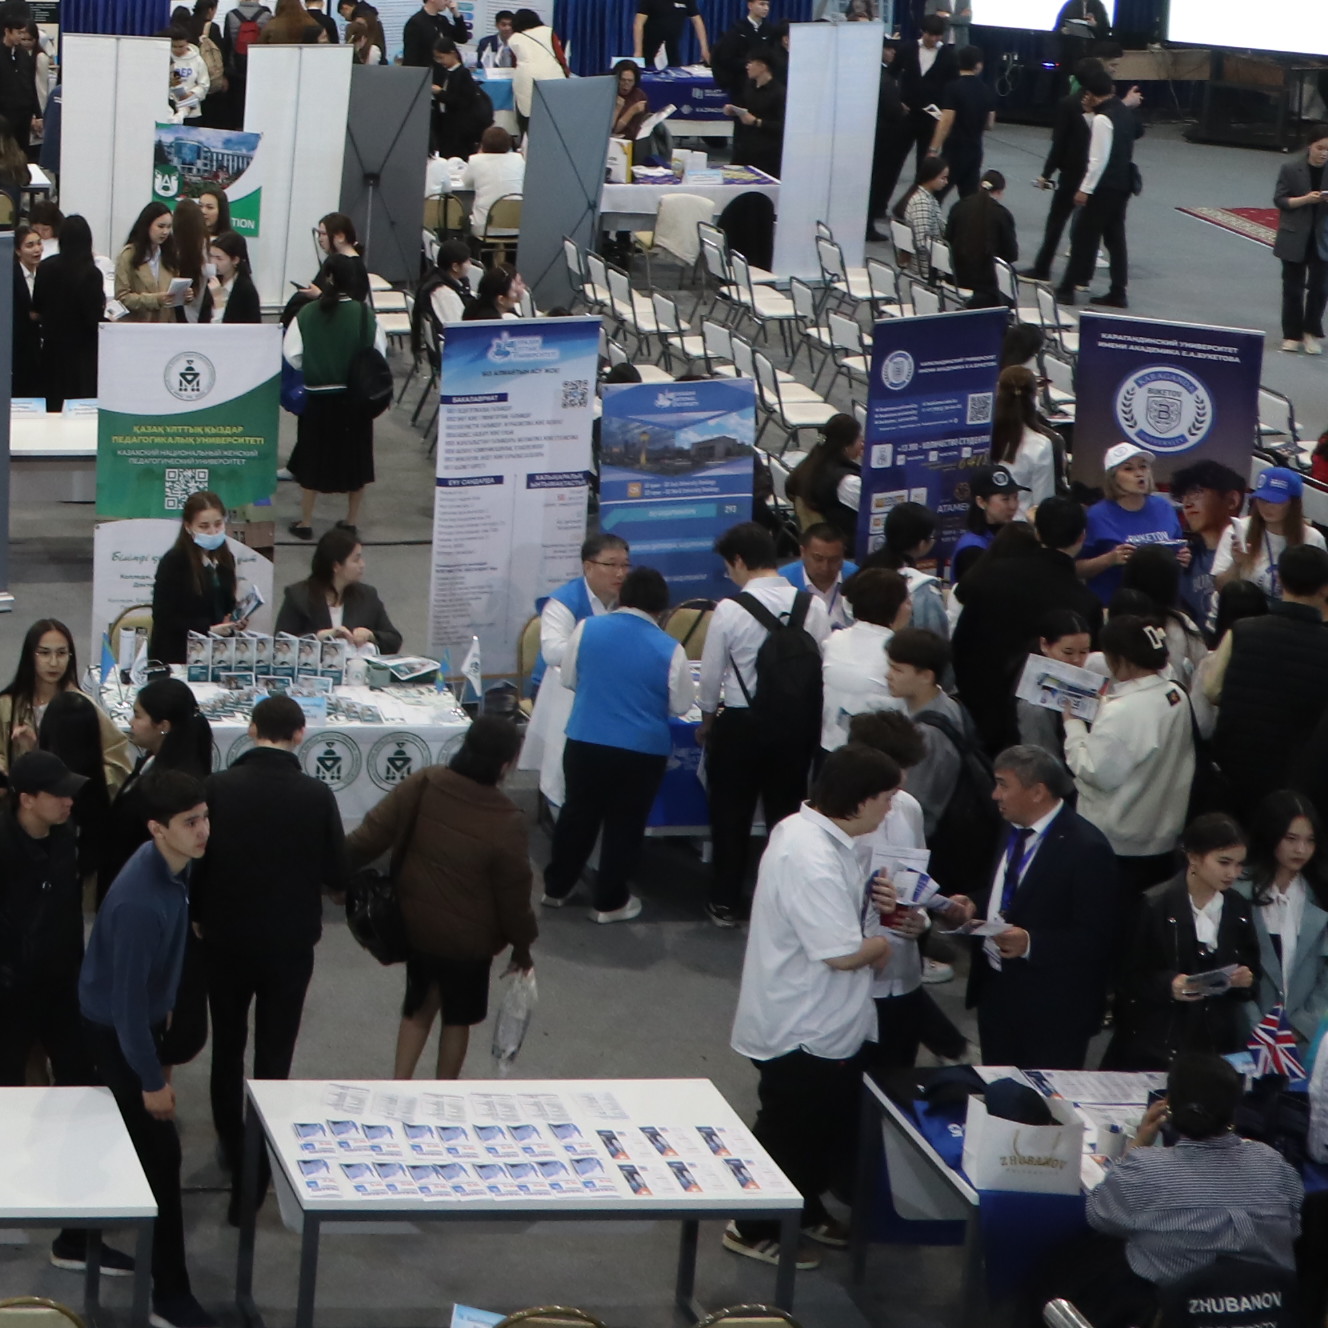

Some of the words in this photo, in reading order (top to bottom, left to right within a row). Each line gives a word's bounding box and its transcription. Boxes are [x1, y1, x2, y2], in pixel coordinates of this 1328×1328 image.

[1097, 341, 1128, 349] ИМЕНИ
[1129, 345, 1180, 356] АКАДЕМИКА
[1101, 333, 1178, 347] КАРАГАНДИНСКИЙ
[1179, 341, 1239, 354] УНИВЕРСИТЕТ
[133, 426, 164, 434] ҚАЗАҚ
[165, 426, 204, 434] ҰЛТТЫҚ
[204, 426, 243, 434] ҚЫЗДАР
[112, 436, 195, 445] ПЕДАГОГИКАЛЫҚ
[195, 436, 264, 445] УНИВЕРСИТЕТІ
[1188, 1291, 1282, 1314] ZHUBANOV
